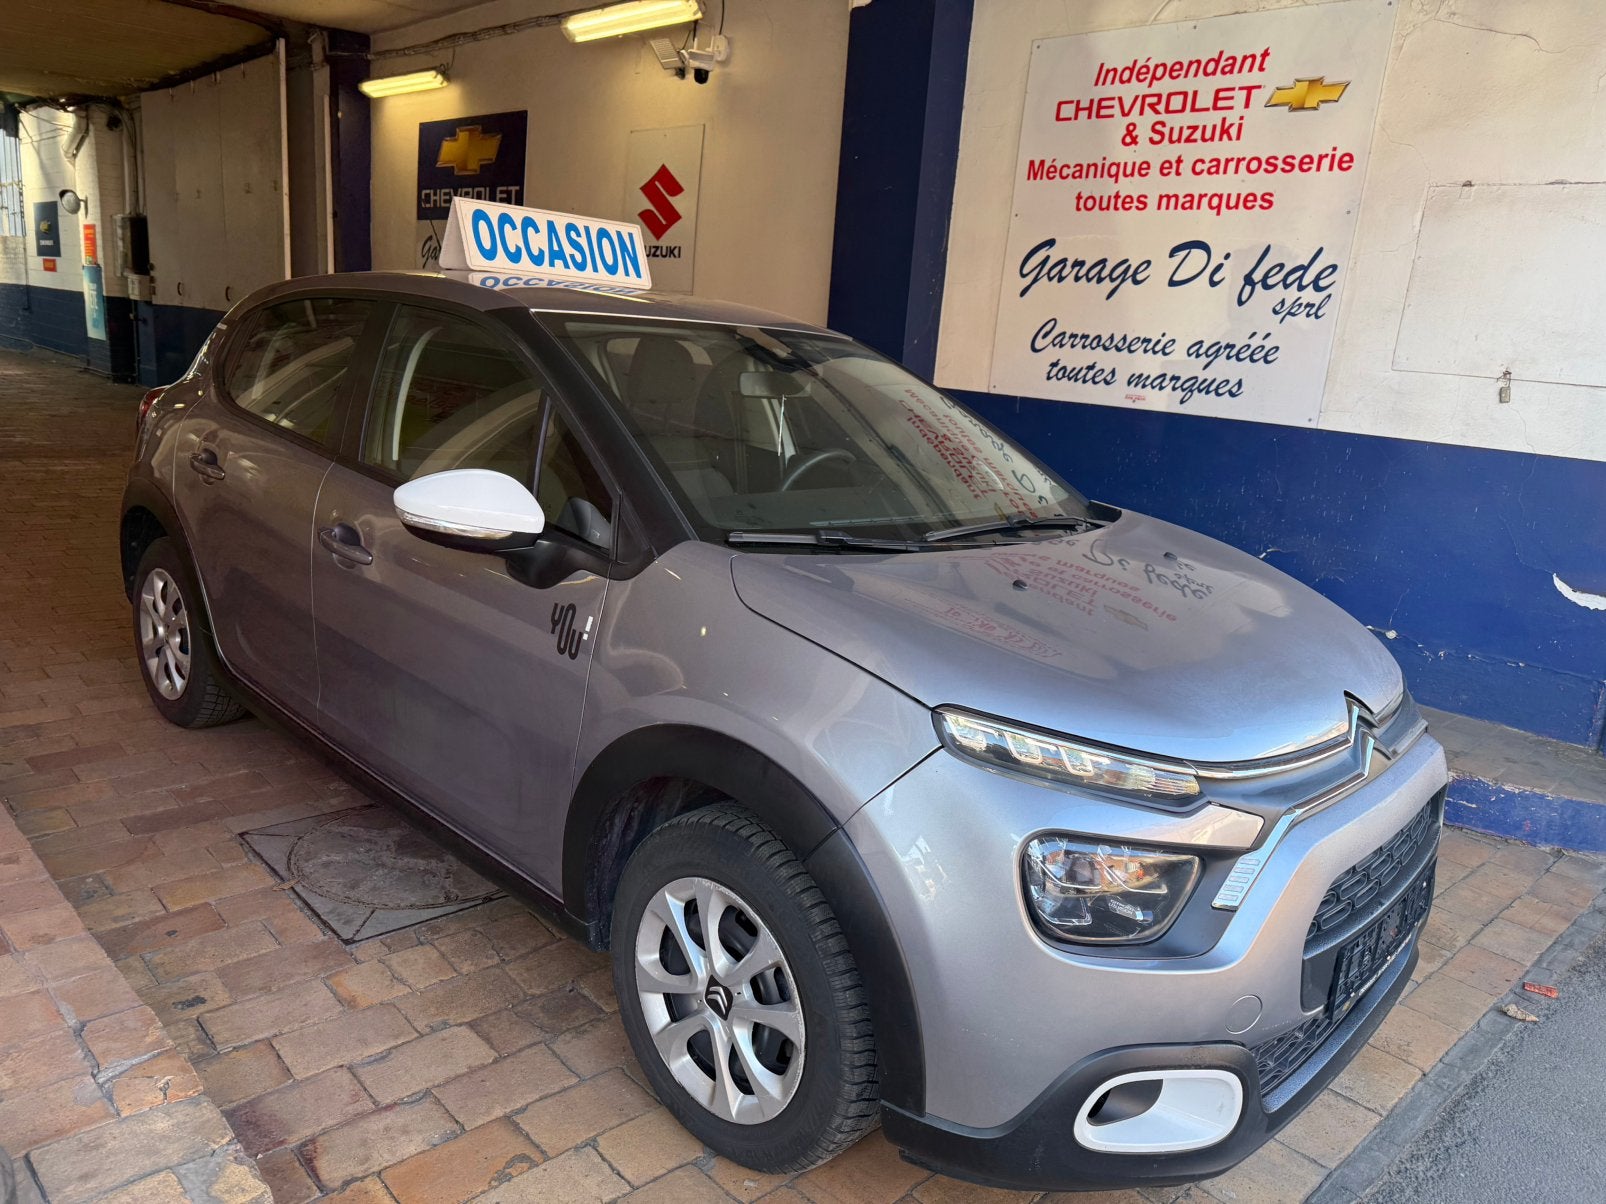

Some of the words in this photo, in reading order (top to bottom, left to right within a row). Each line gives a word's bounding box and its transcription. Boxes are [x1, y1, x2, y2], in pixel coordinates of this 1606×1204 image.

[1094, 46, 1271, 89] Indépendant
[1055, 85, 1263, 122] CHEVROLET
[1121, 122, 1140, 148] &
[1148, 116, 1245, 147] Suzuki
[1027, 155, 1153, 185] Mécanique
[1159, 155, 1185, 179] et
[1191, 147, 1355, 177] carrosserie
[1075, 190, 1149, 213] toutes
[1156, 191, 1275, 217] marques
[471, 209, 642, 279] OCCASION
[645, 245, 681, 259] UZUKI
[1019, 238, 1152, 301] Garage
[1167, 239, 1232, 288] Di
[1236, 244, 1339, 307] fede
[1271, 293, 1332, 325] sprl
[1030, 318, 1176, 357] Carrosserie
[1186, 331, 1280, 371] agréée
[1046, 358, 1117, 386] toutes
[1126, 372, 1244, 405] marques
